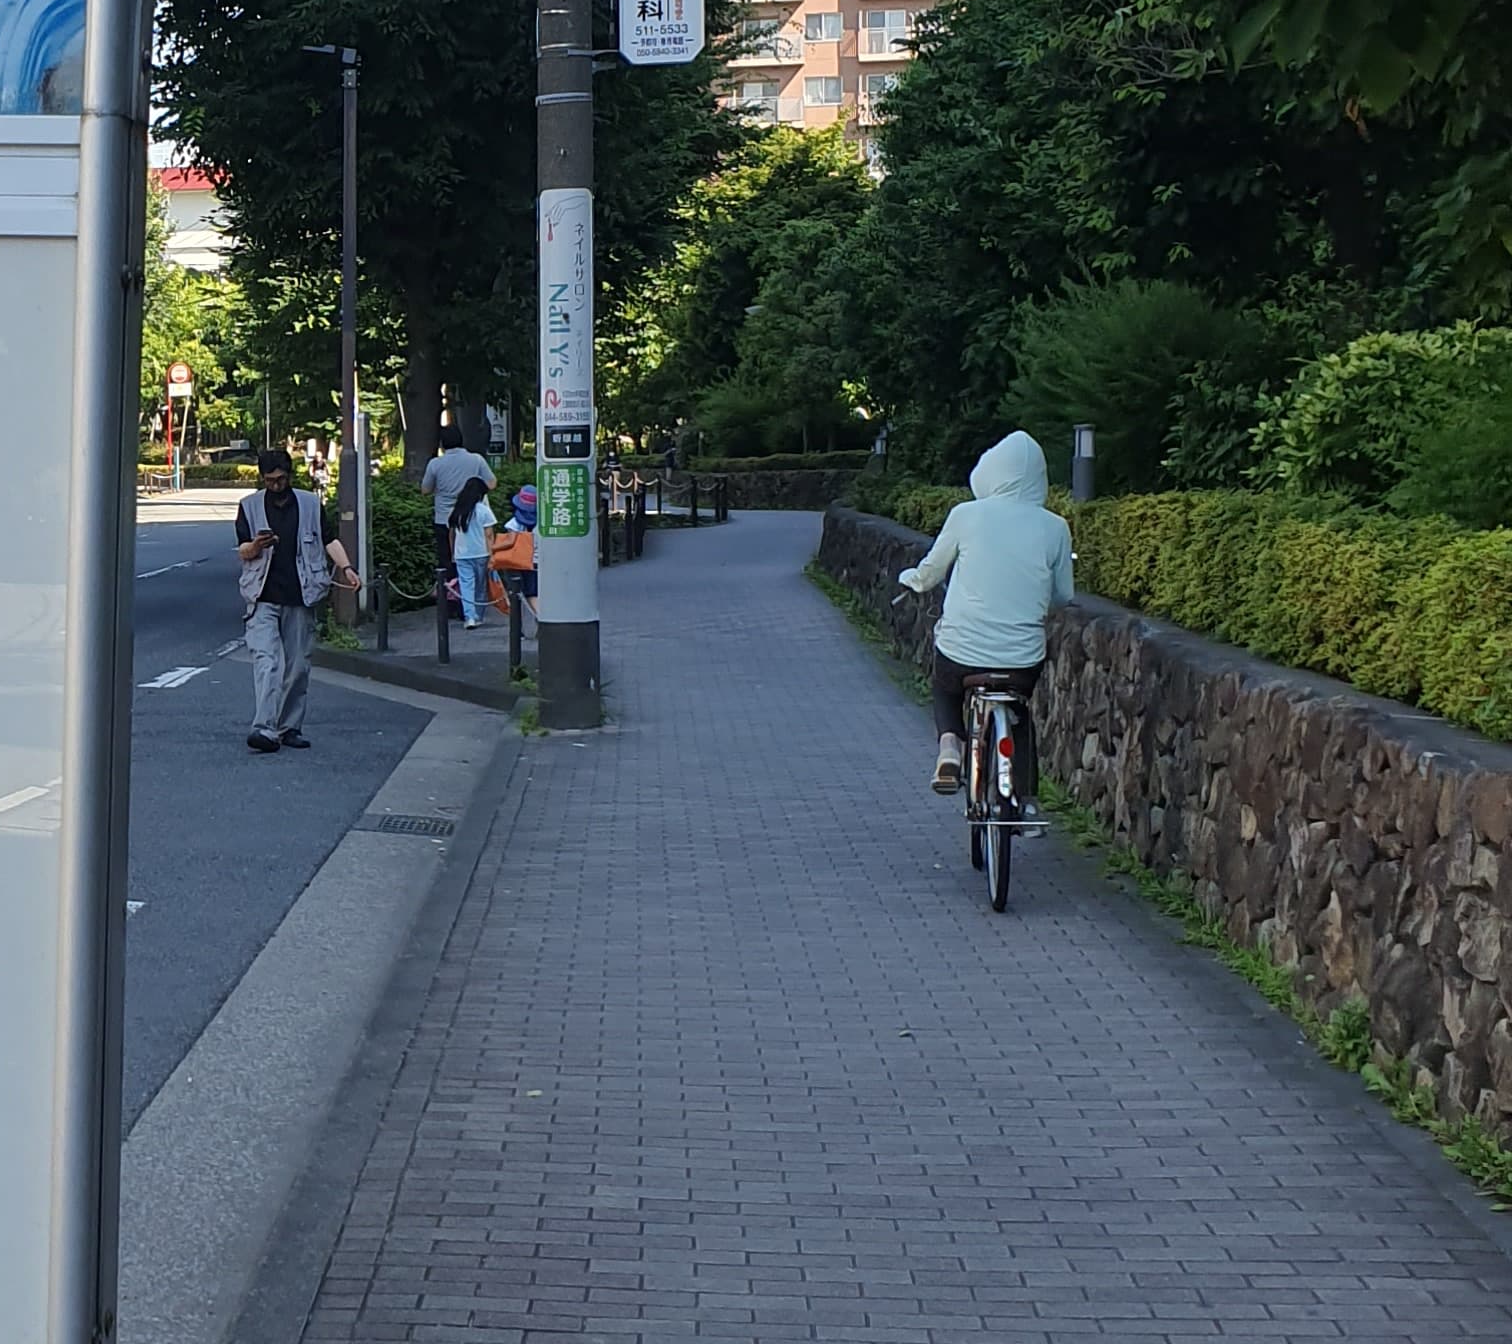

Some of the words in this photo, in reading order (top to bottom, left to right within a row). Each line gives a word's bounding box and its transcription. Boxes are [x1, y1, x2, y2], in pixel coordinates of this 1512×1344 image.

[574, 222, 585, 311] ネイルサロン
[549, 283, 571, 334] Nail
[549, 341, 569, 379] Y's
[552, 468, 572, 526] 通学路
